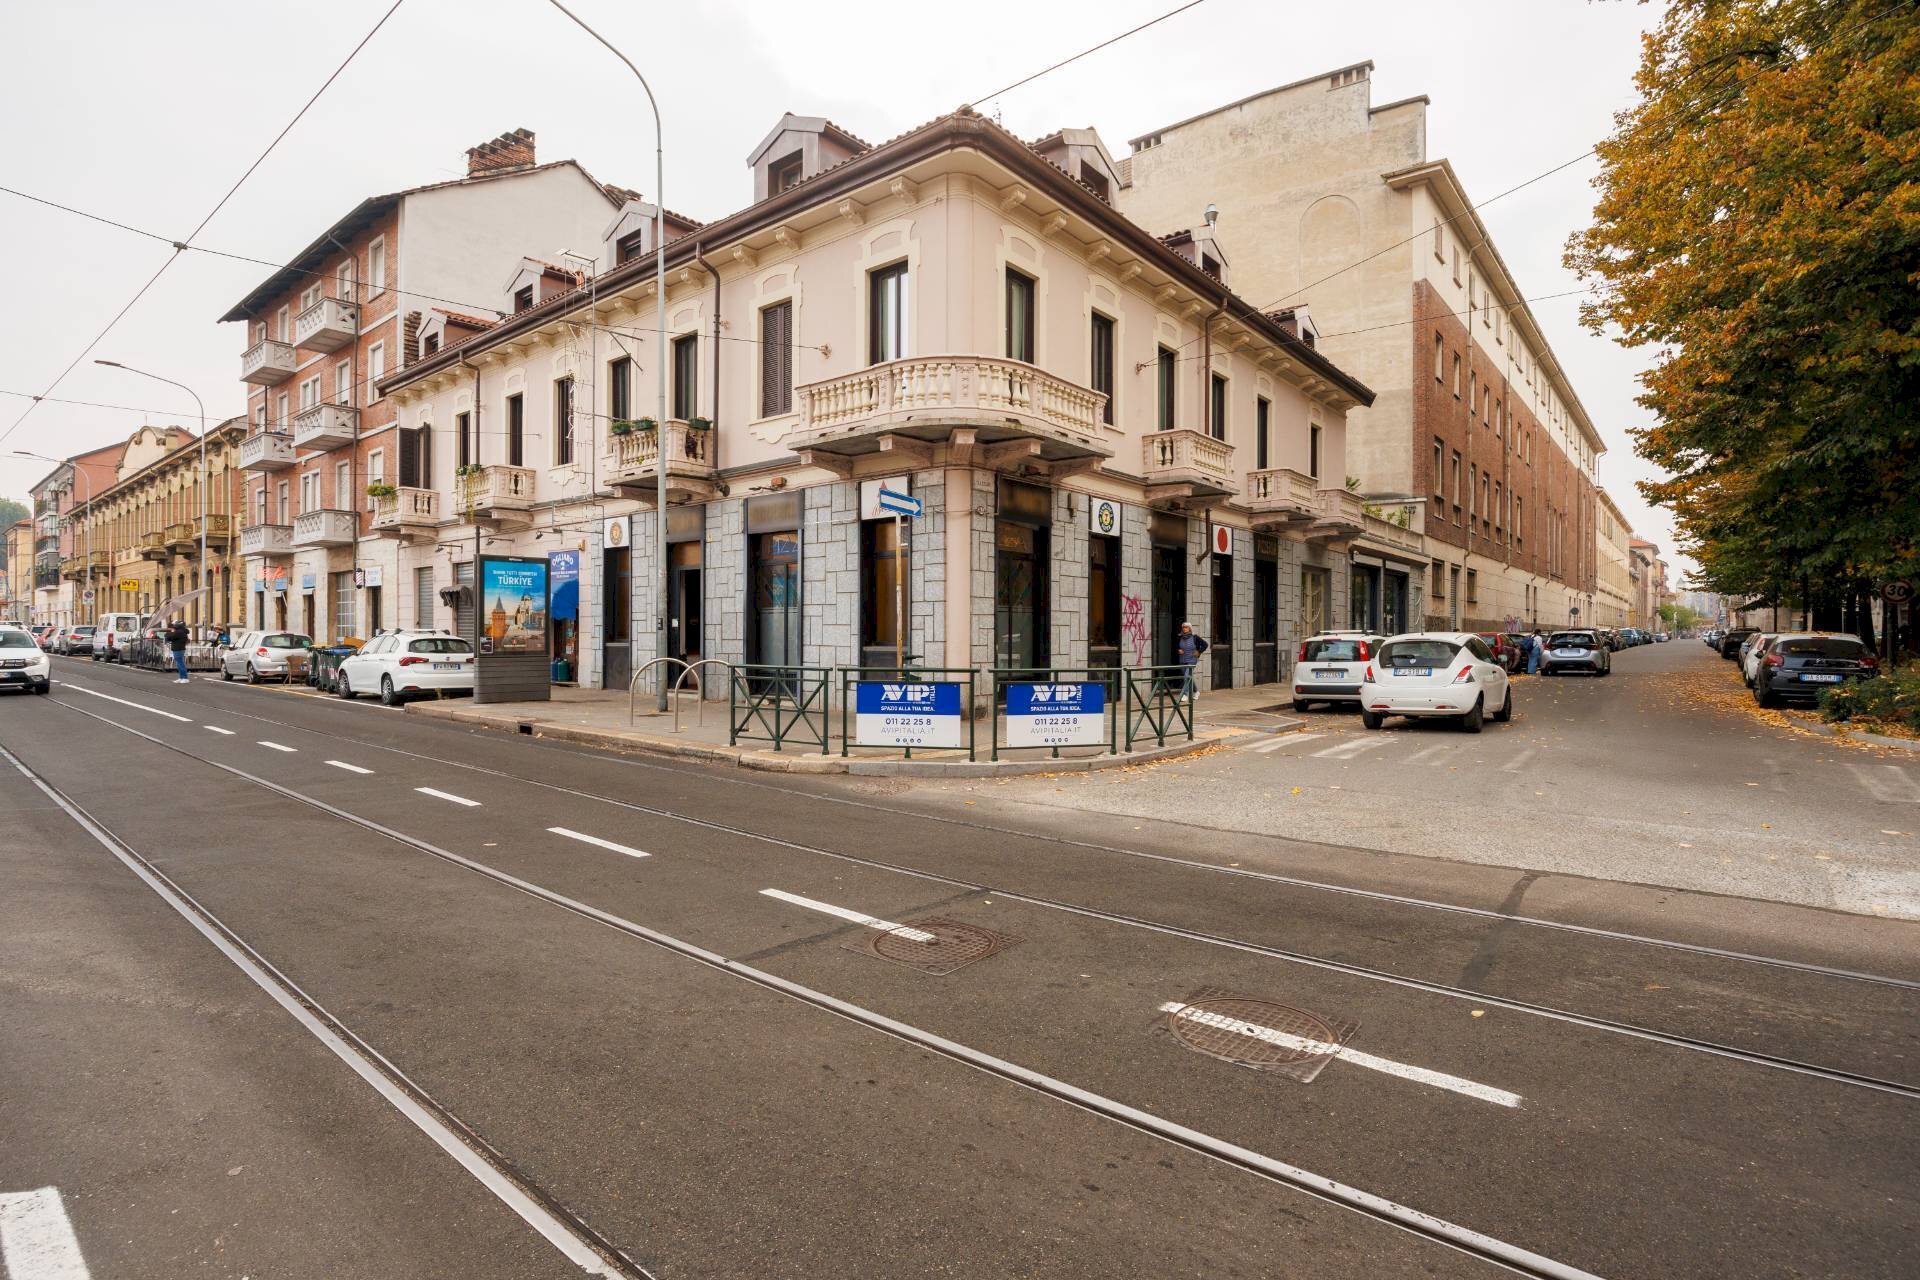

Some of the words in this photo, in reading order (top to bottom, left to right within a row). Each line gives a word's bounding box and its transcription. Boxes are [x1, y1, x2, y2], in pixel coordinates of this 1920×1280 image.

[498, 574, 533, 585] TÜRKİYE
[881, 684, 930, 701] AVIP
[1031, 684, 1077, 701] AVIP
